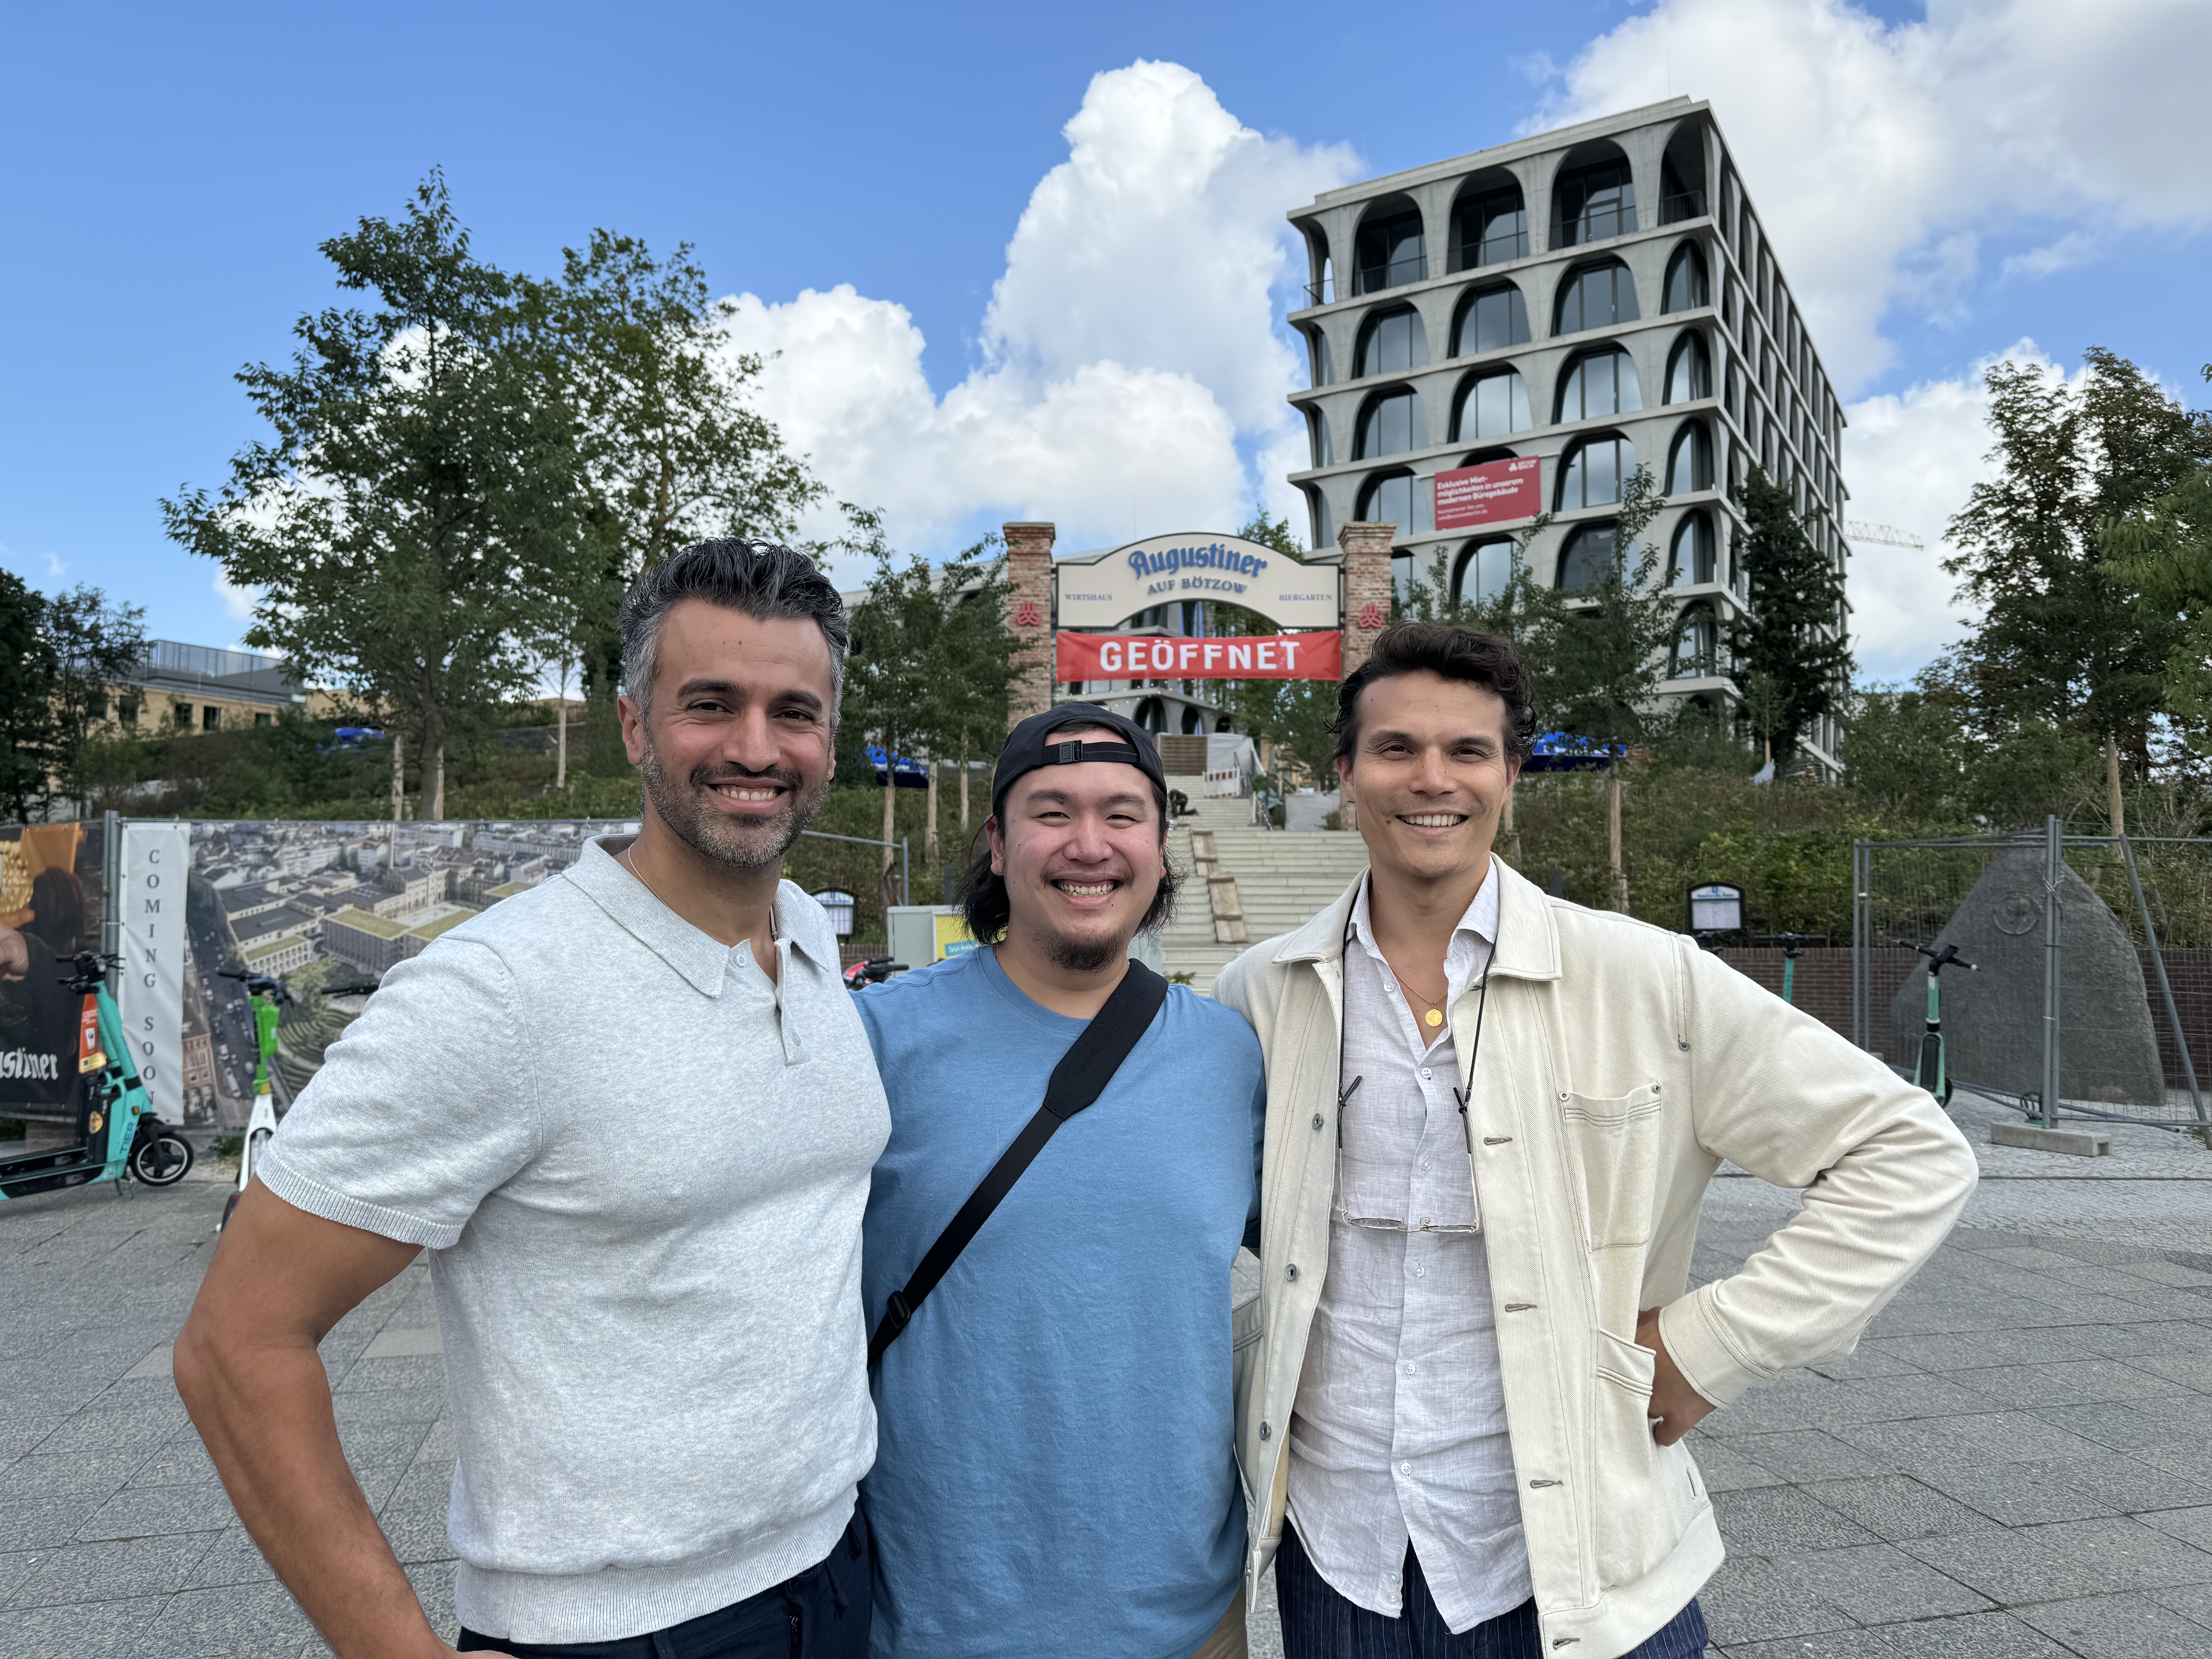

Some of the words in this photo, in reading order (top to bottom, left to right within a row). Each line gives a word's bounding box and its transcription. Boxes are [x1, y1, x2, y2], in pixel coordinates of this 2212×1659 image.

[1437, 479, 1469, 490] Exklusive
[1470, 475, 1488, 484] Miet-
[1437, 484, 1484, 498] möglichkeiten
[1492, 478, 1524, 489] unserem
[1437, 495, 1471, 506] modernen
[1472, 486, 1518, 500] Bürogebäude
[1128, 543, 1267, 580] Augustiner
[1148, 580, 1175, 594] AUF
[1182, 576, 1247, 593] BÖTZOW
[1100, 639, 1300, 672] GEÖFFNET
[144, 849, 161, 988] COMING
[120, 1122, 134, 1154] TIER
